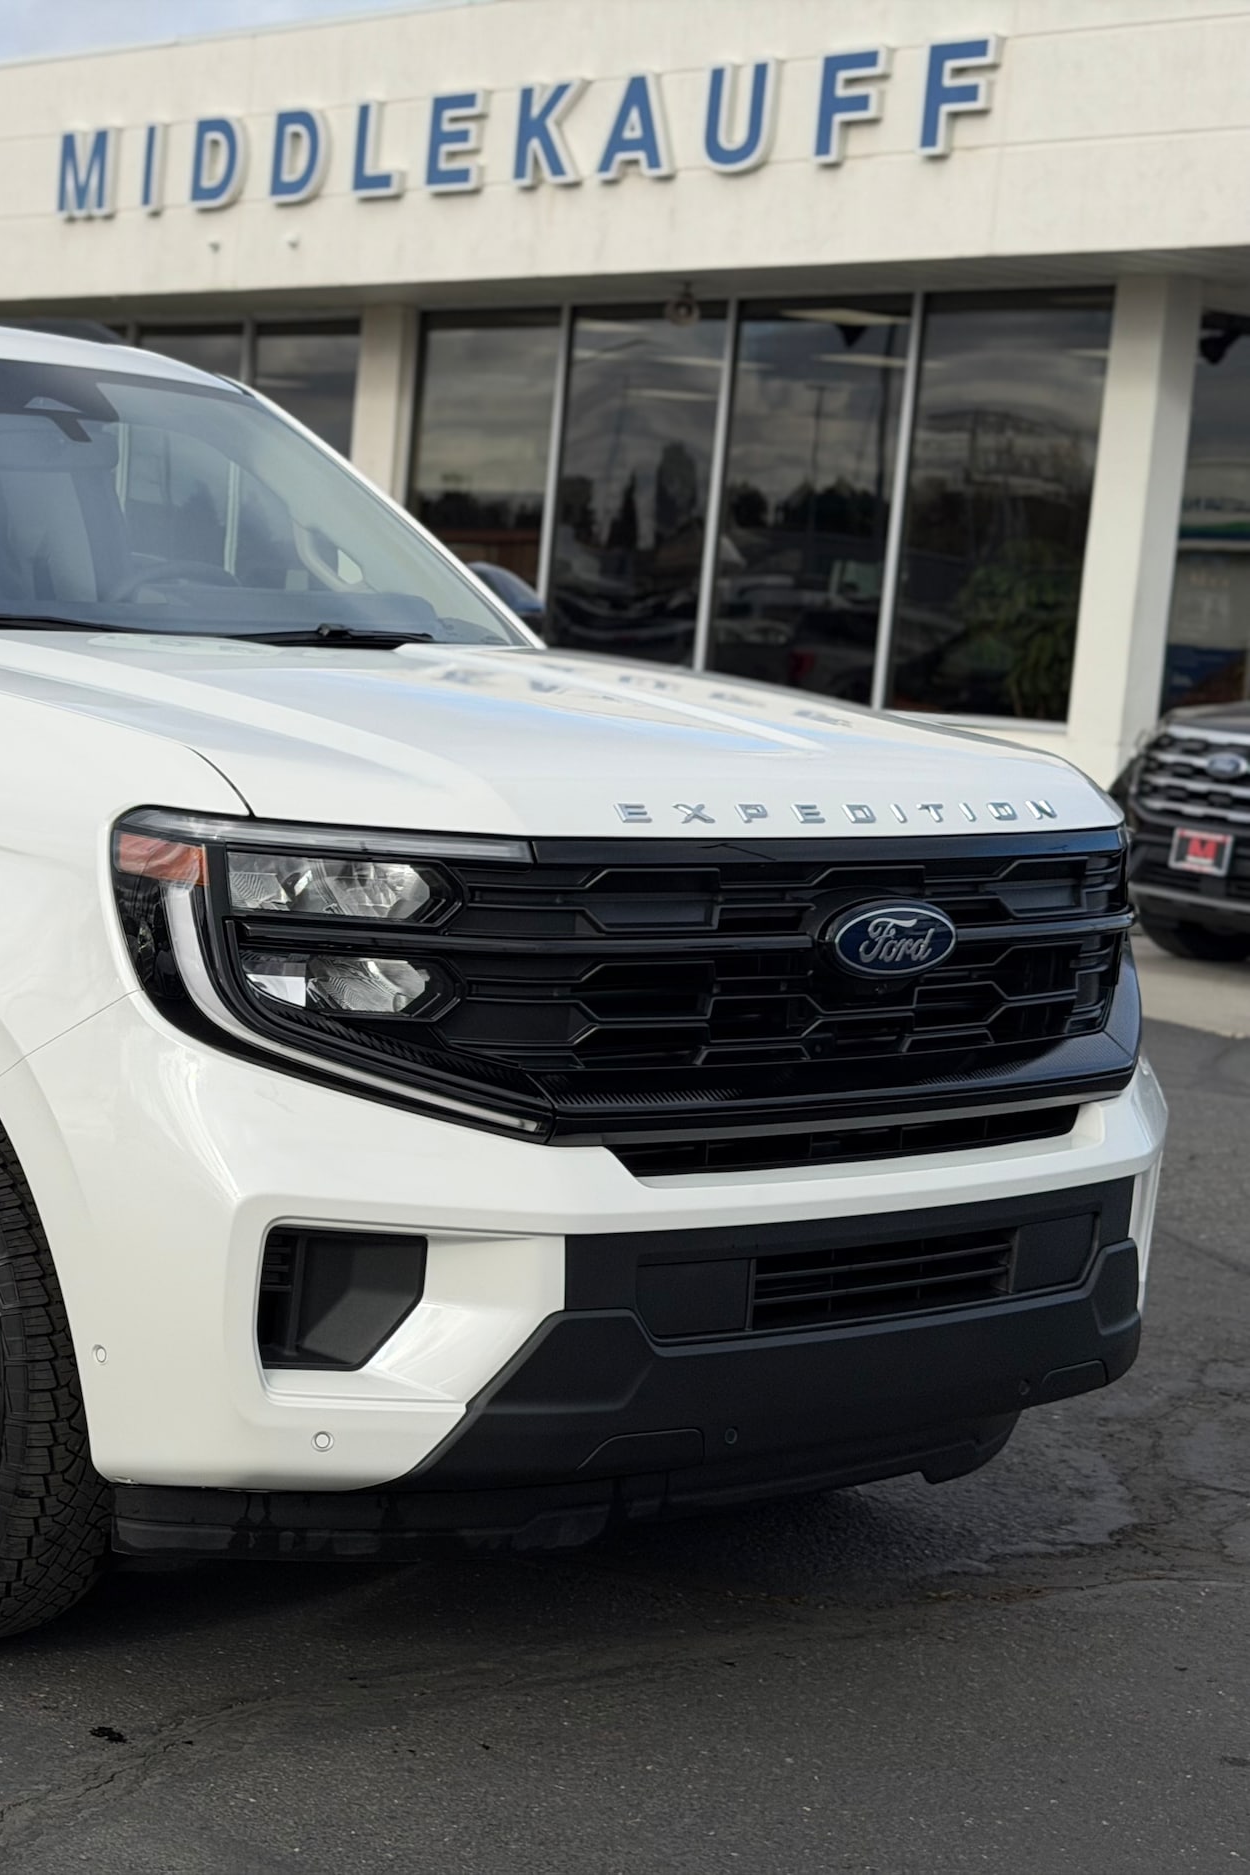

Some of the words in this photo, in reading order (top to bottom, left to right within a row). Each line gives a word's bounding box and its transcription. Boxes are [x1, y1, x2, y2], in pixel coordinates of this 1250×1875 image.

[56, 36, 999, 220] MIDDLEKAUFF
[614, 800, 1058, 824] EXPEDITION
[859, 917, 934, 963] Ford
